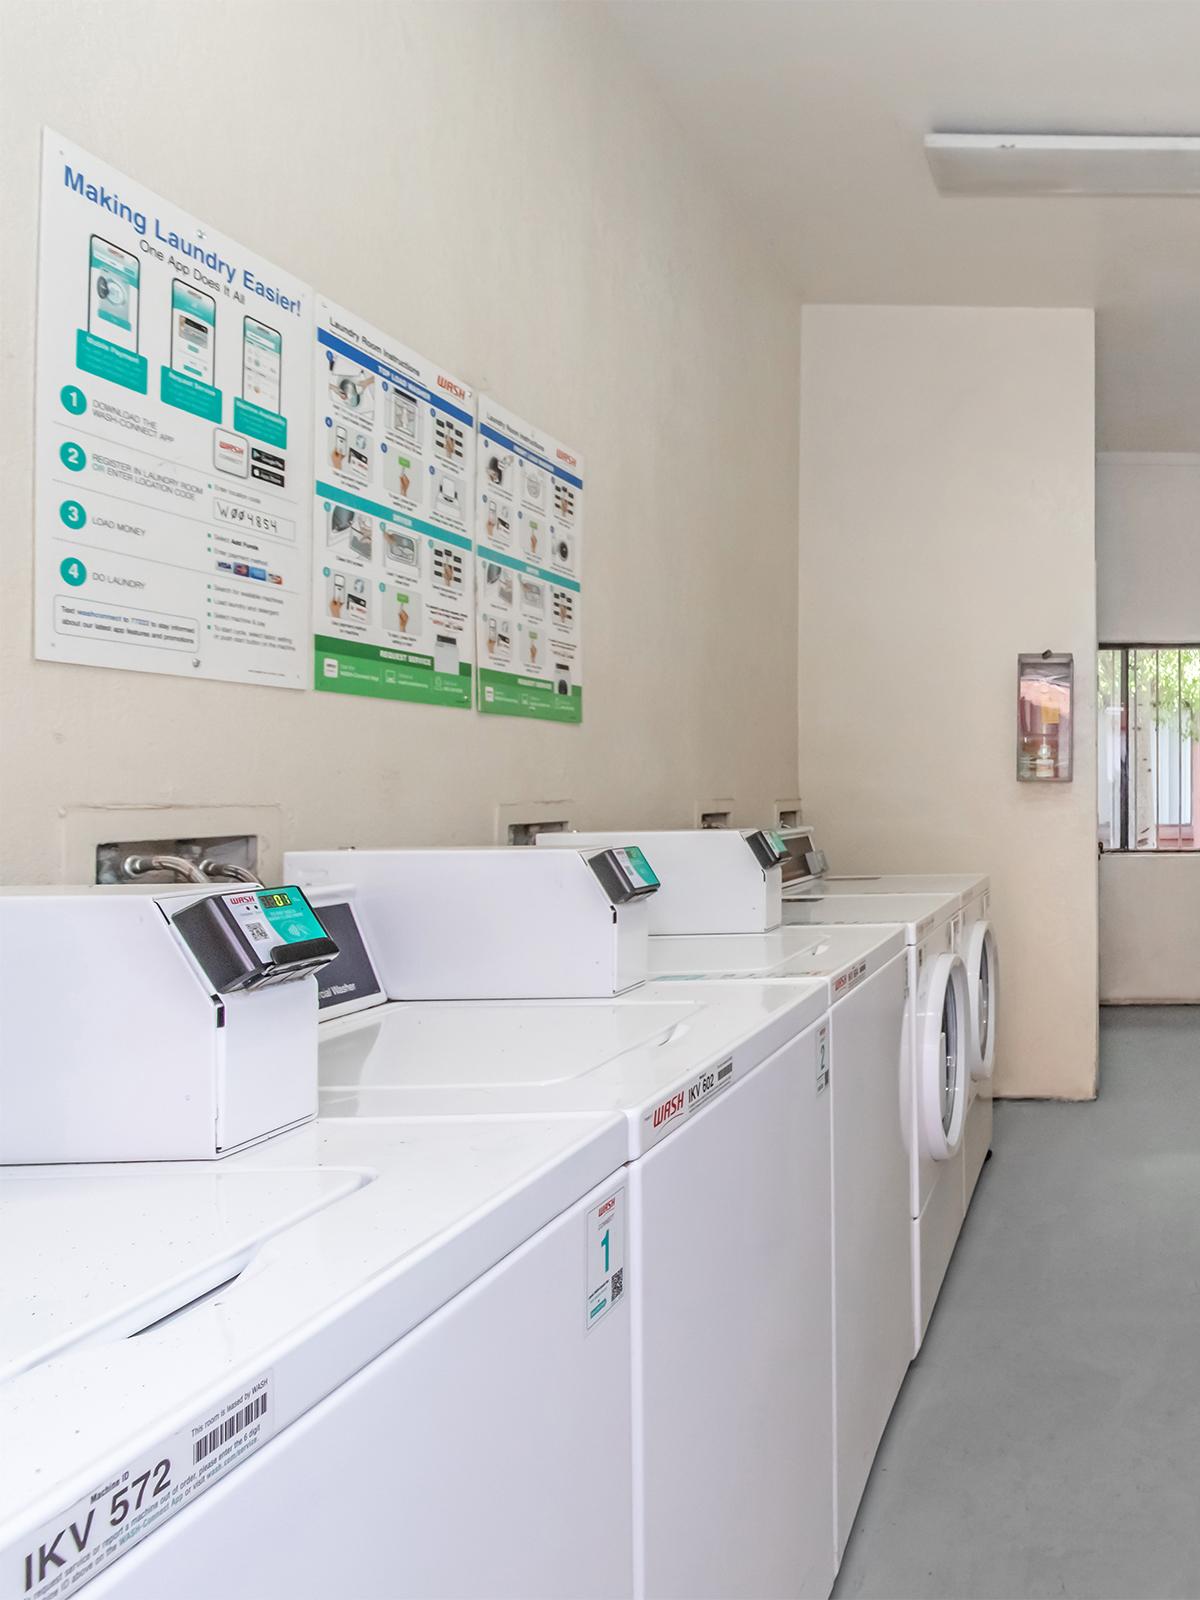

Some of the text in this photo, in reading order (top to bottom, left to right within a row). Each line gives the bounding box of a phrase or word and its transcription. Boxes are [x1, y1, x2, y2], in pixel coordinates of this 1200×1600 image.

[64, 164, 301, 317] Making Laundry Easier!
[139, 238, 246, 305] One App Does It All
[330, 316, 420, 377] Laundry Room Instructions
[70, 392, 78, 407] 1
[436, 375, 466, 400] WASH
[92, 400, 158, 430] DOWNLOAD THE
[92, 408, 174, 442] WASH-CONNECT APP
[68, 448, 80, 464] 2
[92, 454, 132, 474] REGISTER
[134, 466, 142, 476] IN
[144, 470, 179, 486] LAUNDRY
[180, 481, 204, 495] ROOM
[92, 462, 196, 500] OR ENTER LOCATION CODE
[68, 506, 80, 522] 3
[92, 516, 146, 536] LOAD MONEY
[68, 562, 80, 579] 4
[92, 572, 146, 590] DO LAUNDRY
[230, 896, 256, 905] WASH
[654, 1073, 714, 1128] WASH IKV 602
[598, 1197, 616, 1218] WASH
[600, 1229, 610, 1272] 1
[192, 1424, 204, 1438] This
[204, 1412, 220, 1428] room
[252, 1378, 268, 1394] WASH
[90, 1471, 130, 1504] Machine ID
[102, 1526, 124, 1548] report
[130, 1501, 158, 1528] machine
[160, 1490, 171, 1506] out
[198, 1457, 218, 1476] please
[218, 1444, 233, 1461] enter
[234, 1438, 242, 1450] the
[170, 1492, 184, 1507] App
[24, 1458, 171, 1592] IKV 572
